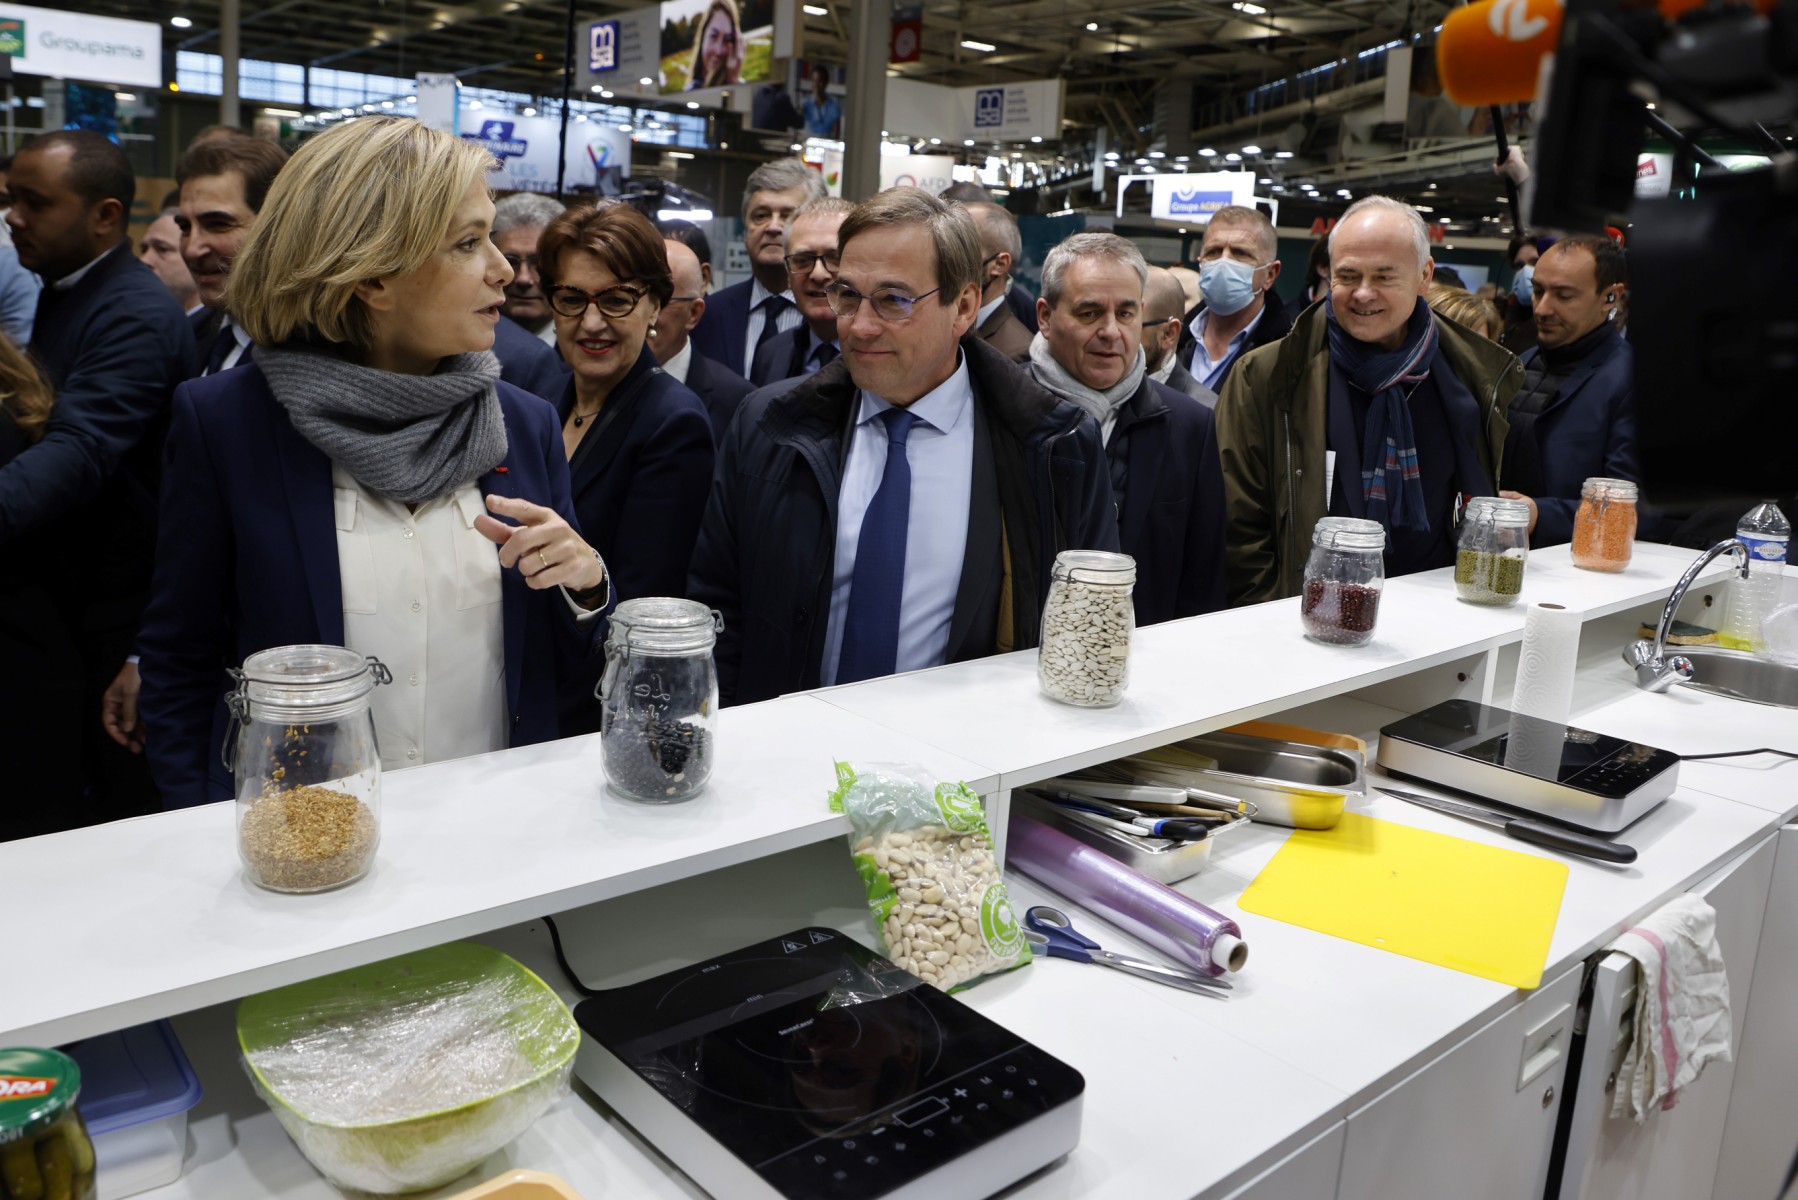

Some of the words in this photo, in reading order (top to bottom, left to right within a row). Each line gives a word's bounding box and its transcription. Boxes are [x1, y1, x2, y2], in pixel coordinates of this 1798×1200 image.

[39, 31, 144, 58] Groupama
[509, 164, 538, 177] LES
[920, 178, 946, 188] AFD
[1171, 201, 1199, 213] Groupe
[702, 963, 721, 974] max
[746, 993, 764, 1003] min
